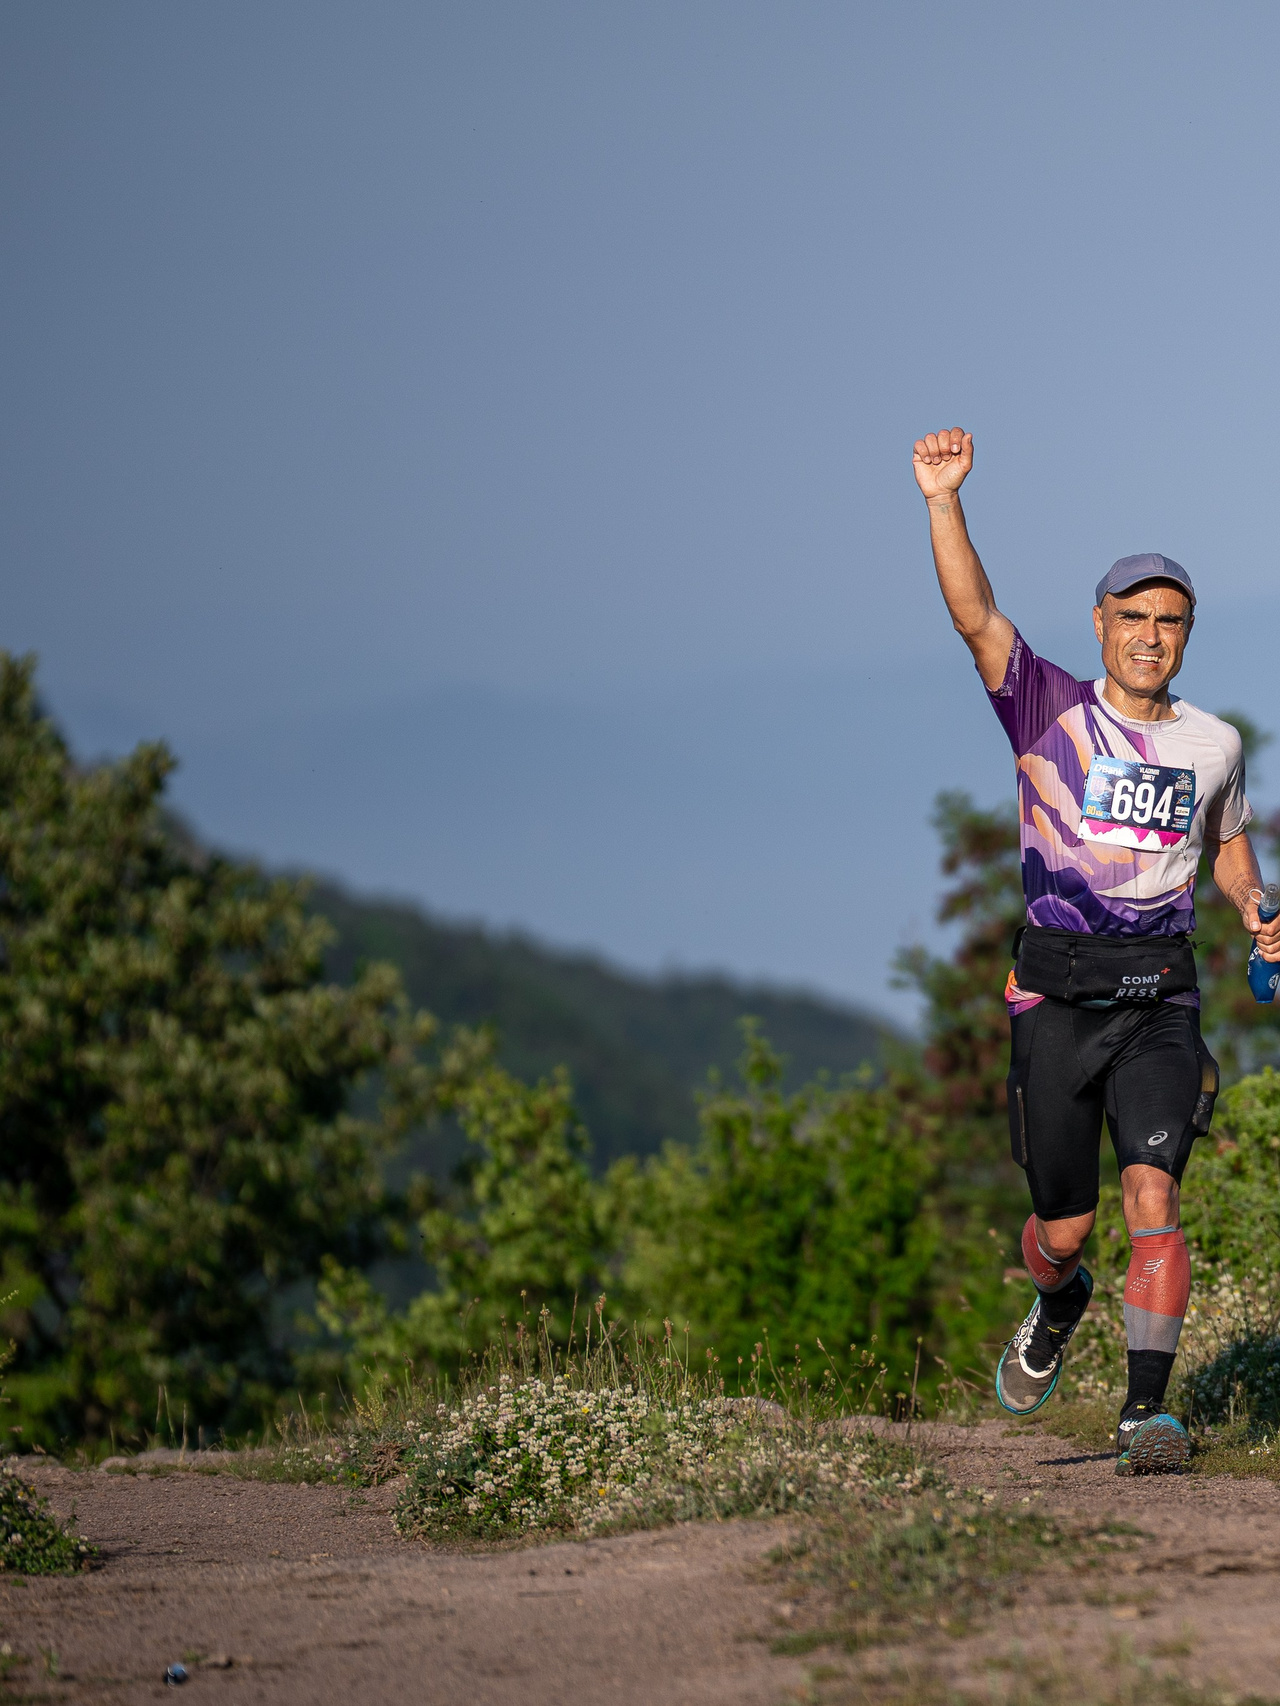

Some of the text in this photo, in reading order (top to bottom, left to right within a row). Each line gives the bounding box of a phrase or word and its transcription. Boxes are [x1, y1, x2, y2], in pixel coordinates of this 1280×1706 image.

[1111, 779, 1174, 827] 694
[1086, 805, 1096, 815] 60
[1122, 974, 1160, 985] COMP
[1115, 987, 1158, 998] RESS
